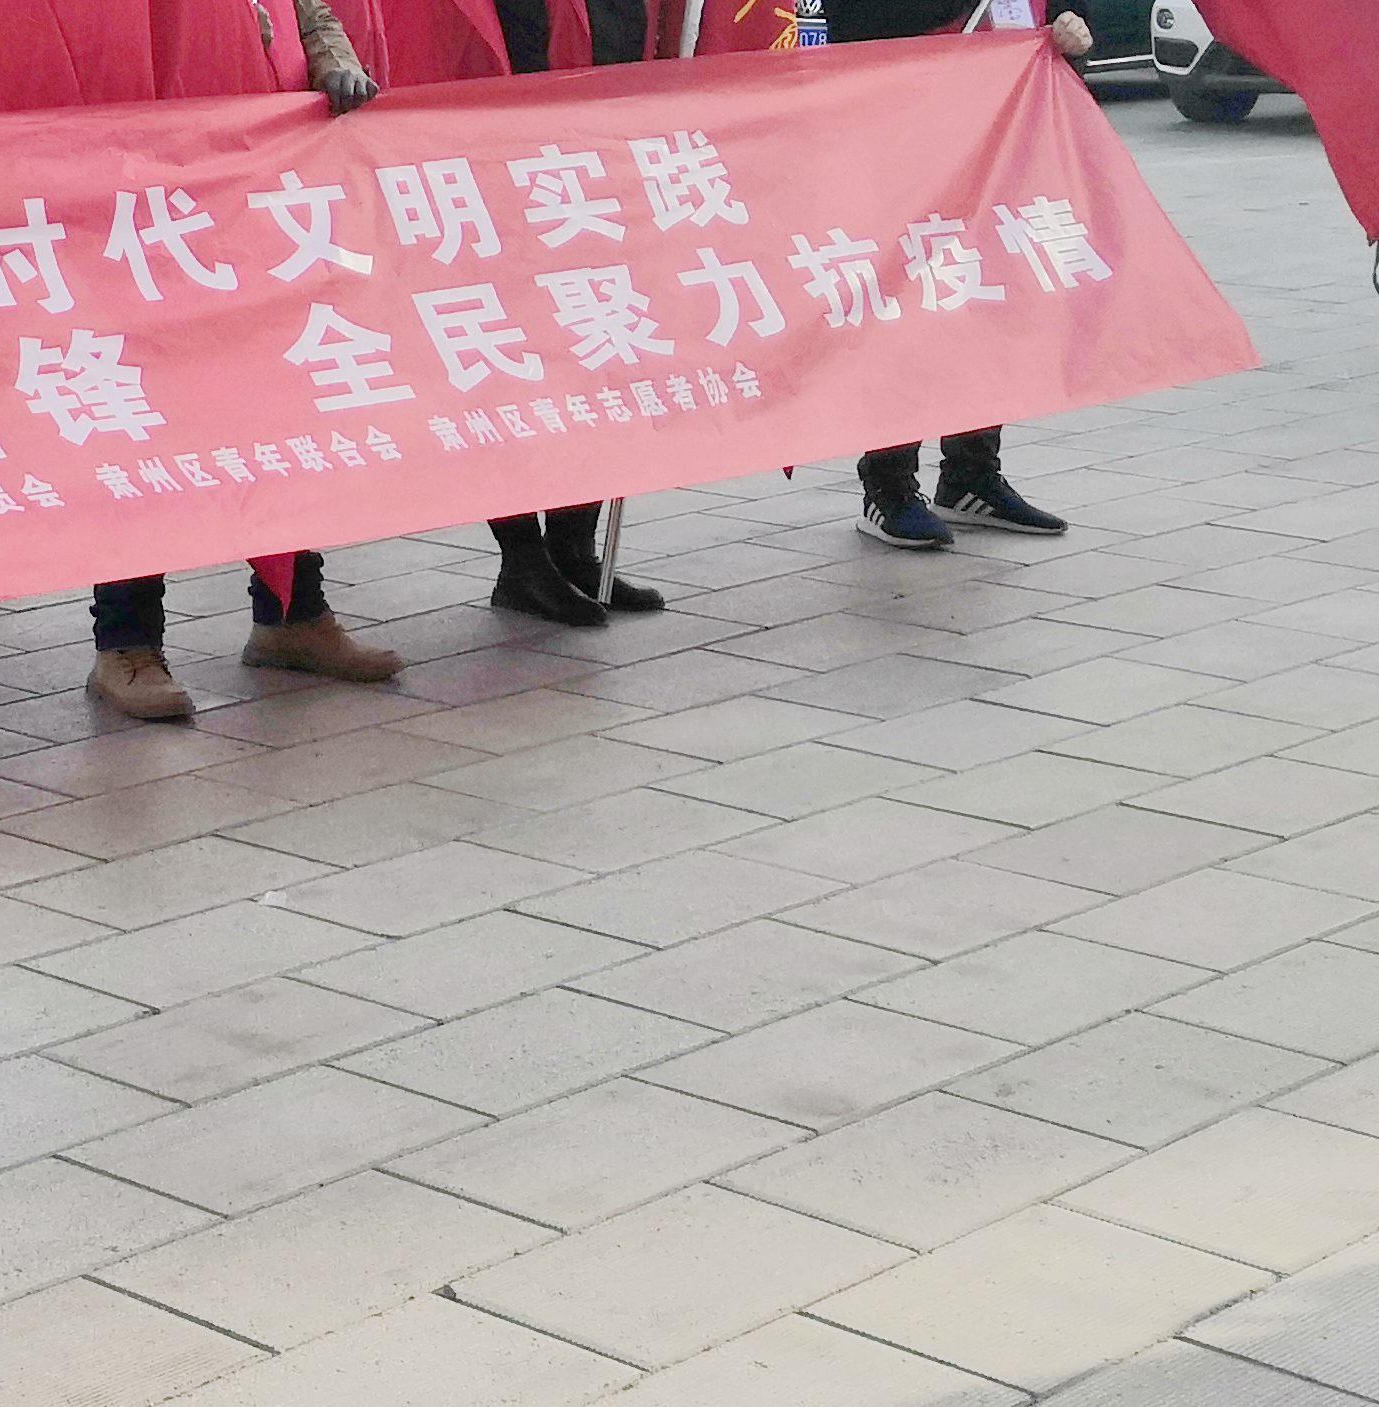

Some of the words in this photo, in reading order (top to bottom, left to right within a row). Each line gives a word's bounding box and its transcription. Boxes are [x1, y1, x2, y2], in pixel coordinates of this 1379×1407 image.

[283, 193, 1114, 412] 全民聚力抗疫情
[94, 425, 404, 500] 肃州区青年联合会
[426, 361, 763, 452] 肃州区青年志愿者协会
